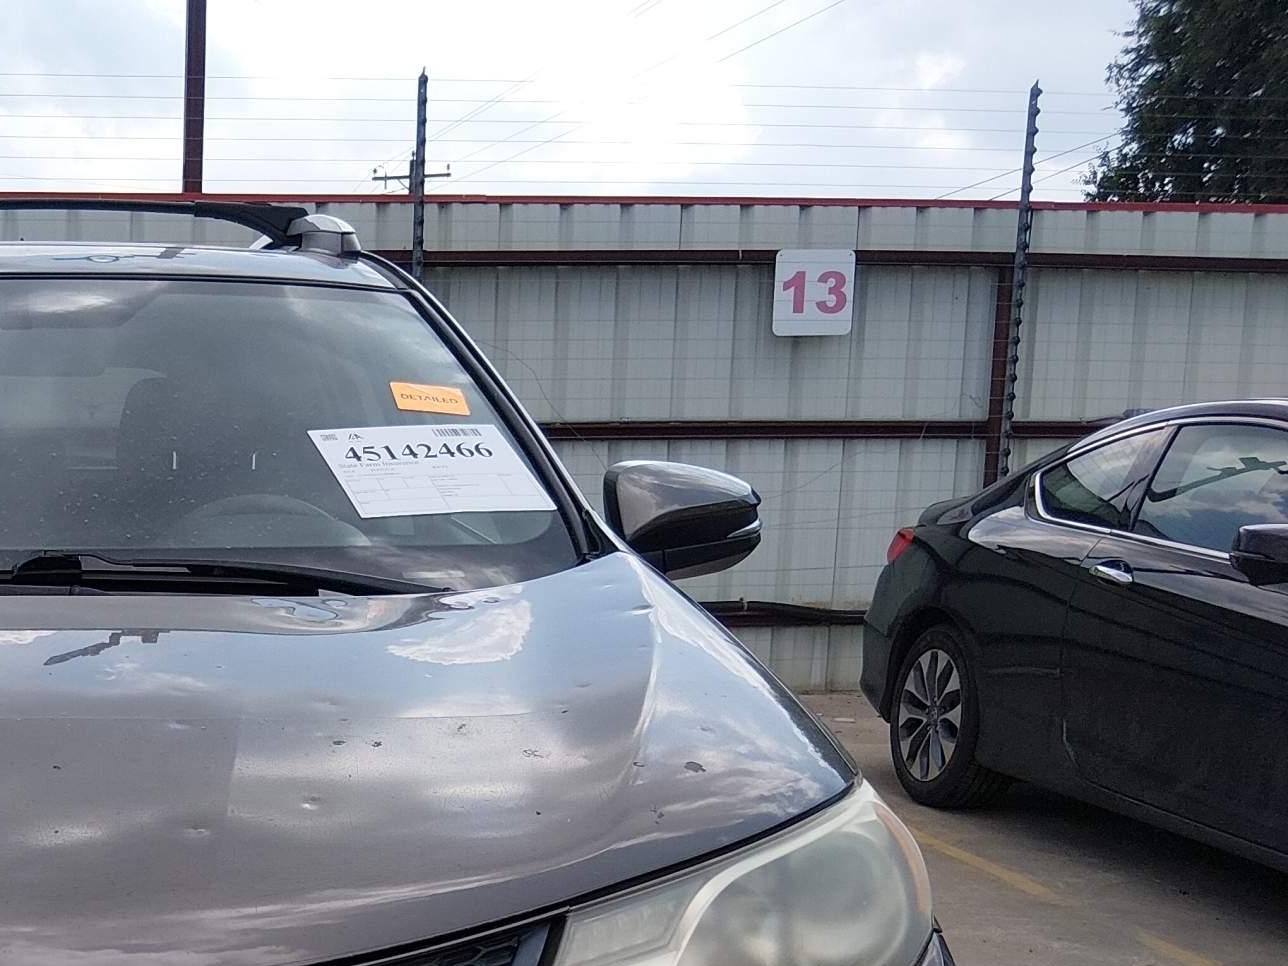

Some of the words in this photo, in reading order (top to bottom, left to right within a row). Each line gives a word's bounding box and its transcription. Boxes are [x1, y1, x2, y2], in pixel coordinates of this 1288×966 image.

[782, 270, 847, 314] 13
[400, 392, 459, 404] DETAILED
[345, 442, 493, 462] 45142466
